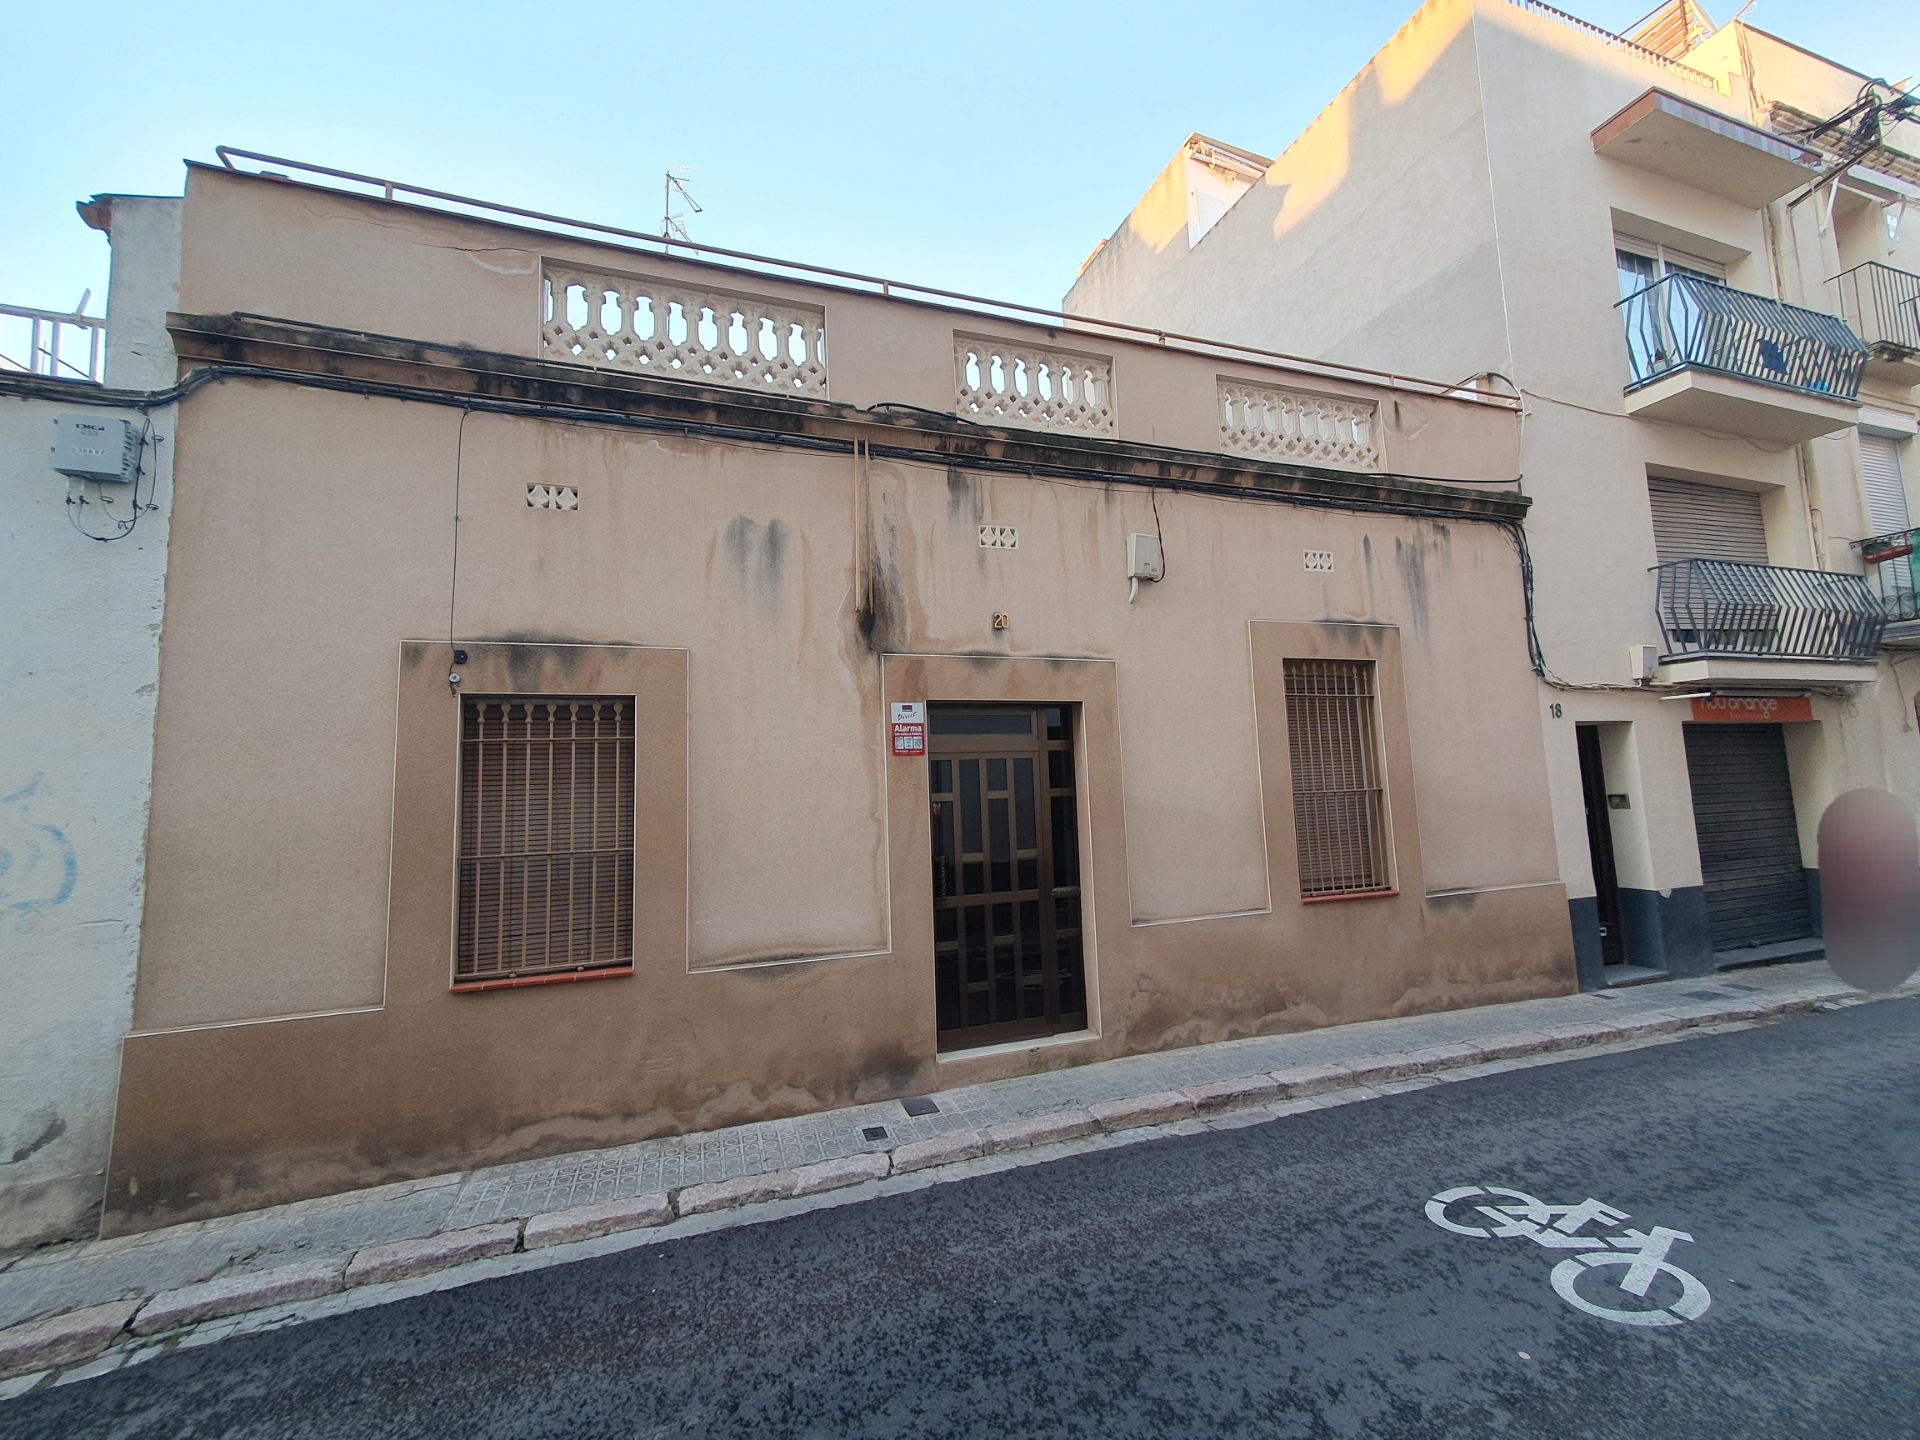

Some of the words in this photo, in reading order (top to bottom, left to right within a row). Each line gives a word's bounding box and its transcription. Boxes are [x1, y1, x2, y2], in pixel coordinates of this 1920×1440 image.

[994, 612, 1009, 628] 20
[1549, 702, 1562, 719] 18
[894, 724, 922, 733] Alarma
